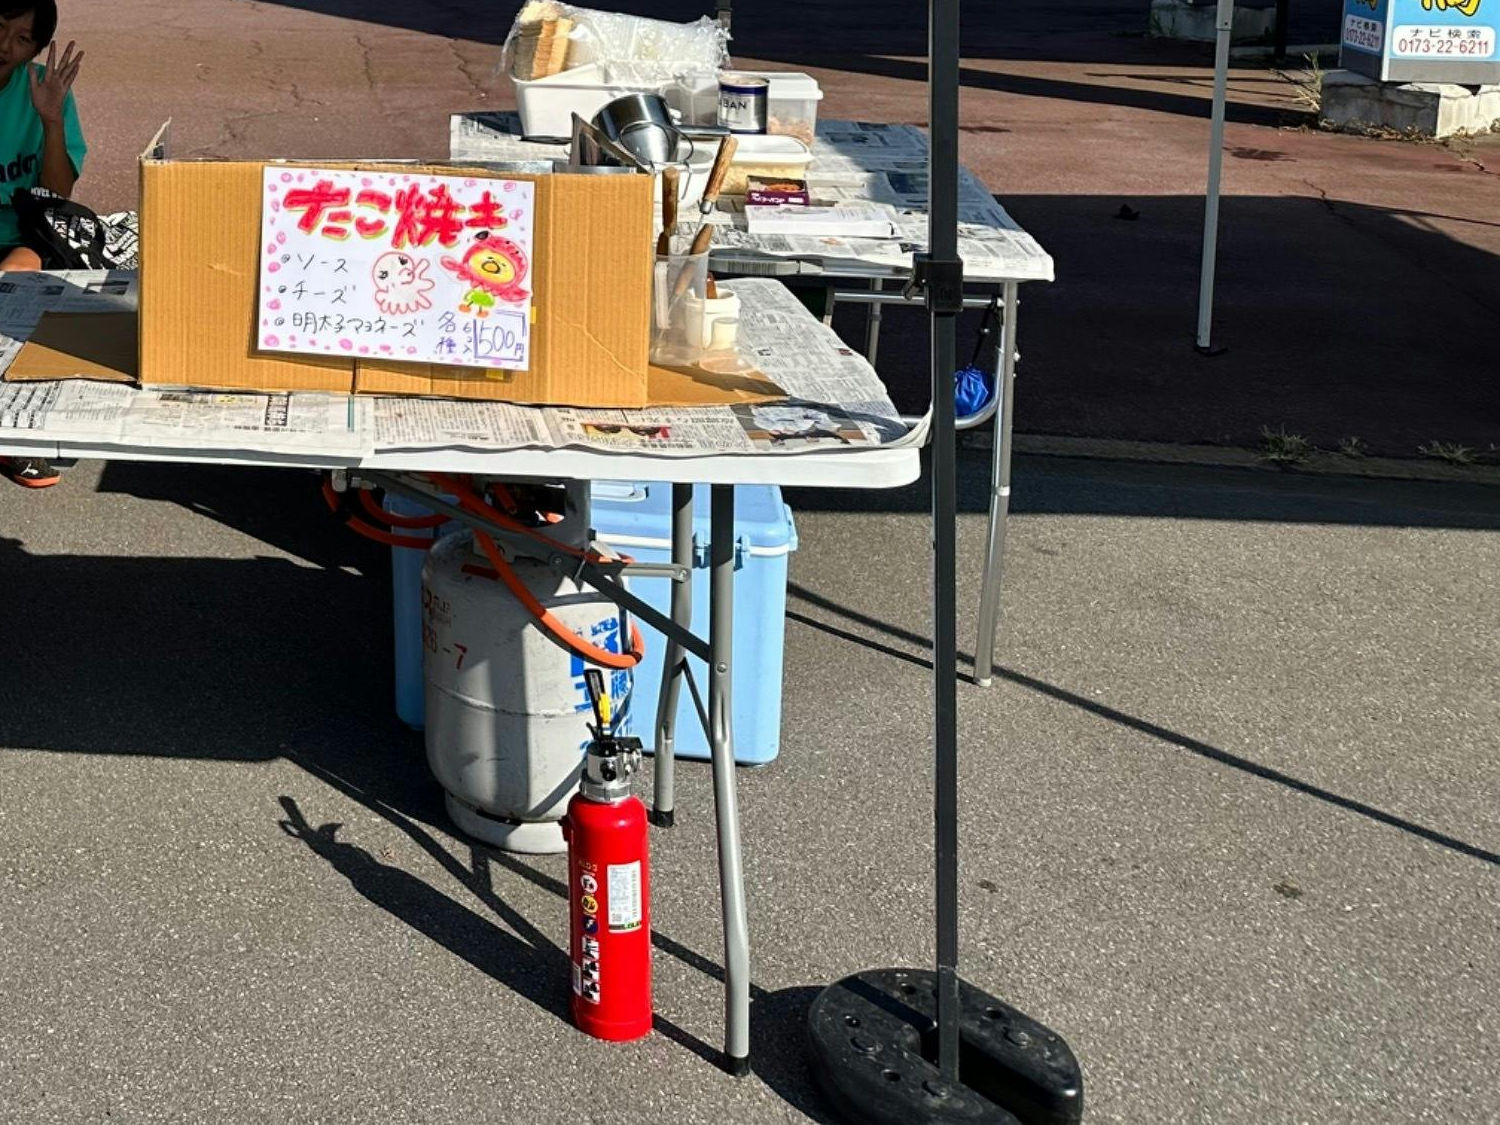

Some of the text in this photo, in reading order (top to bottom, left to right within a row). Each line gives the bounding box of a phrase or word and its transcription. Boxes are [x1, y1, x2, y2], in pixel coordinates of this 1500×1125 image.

[282, 178, 508, 249] たこ焼き
[297, 252, 349, 274] ソース
[292, 280, 357, 305] チーズ
[292, 312, 424, 338] 明太子マヨネーズ
